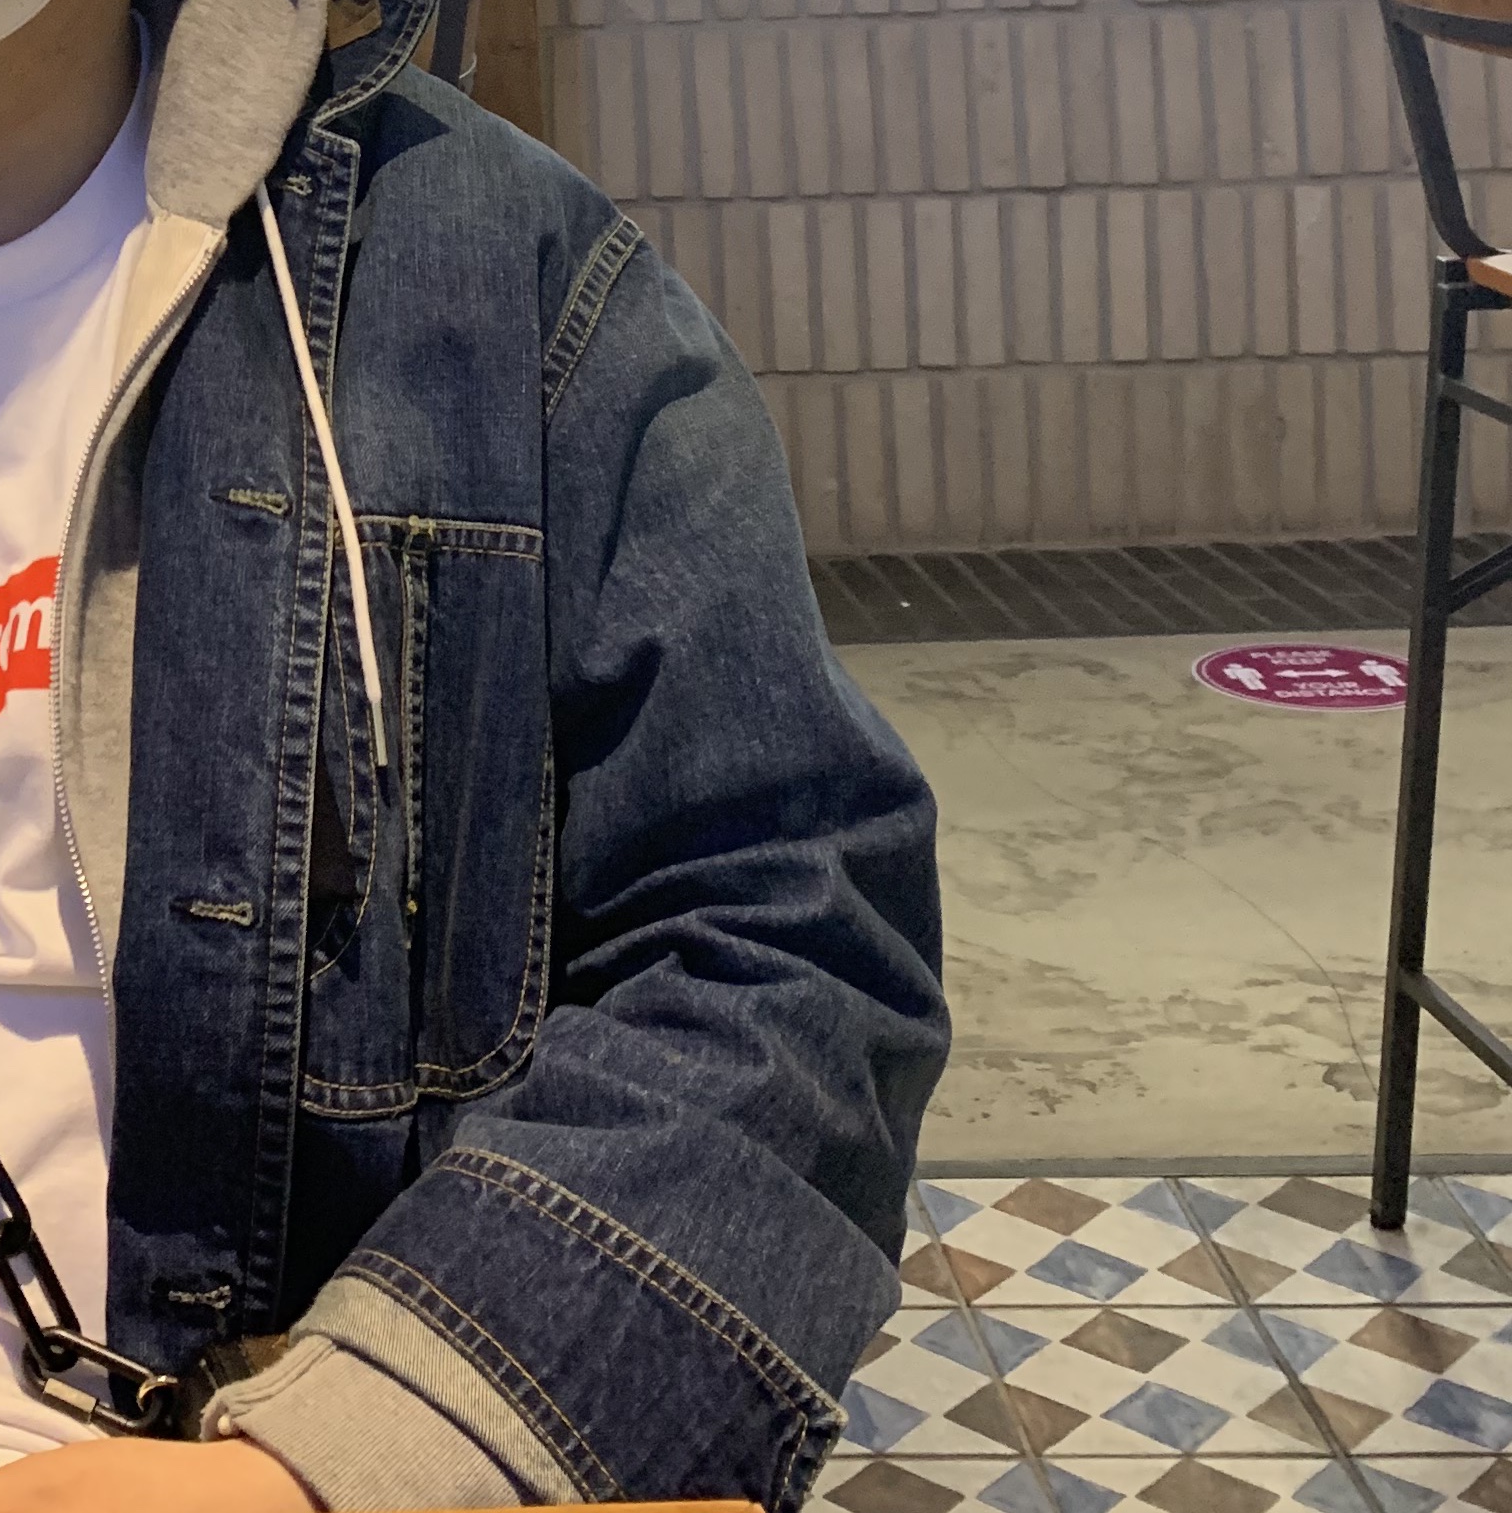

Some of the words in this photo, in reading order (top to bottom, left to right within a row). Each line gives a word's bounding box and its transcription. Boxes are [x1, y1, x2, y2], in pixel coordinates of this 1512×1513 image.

[1250, 650, 1334, 660] PLEASE
[1271, 657, 1327, 665] KEEP
[1292, 681, 1359, 689] YOUR
[1274, 688, 1397, 698] DISTANCE
